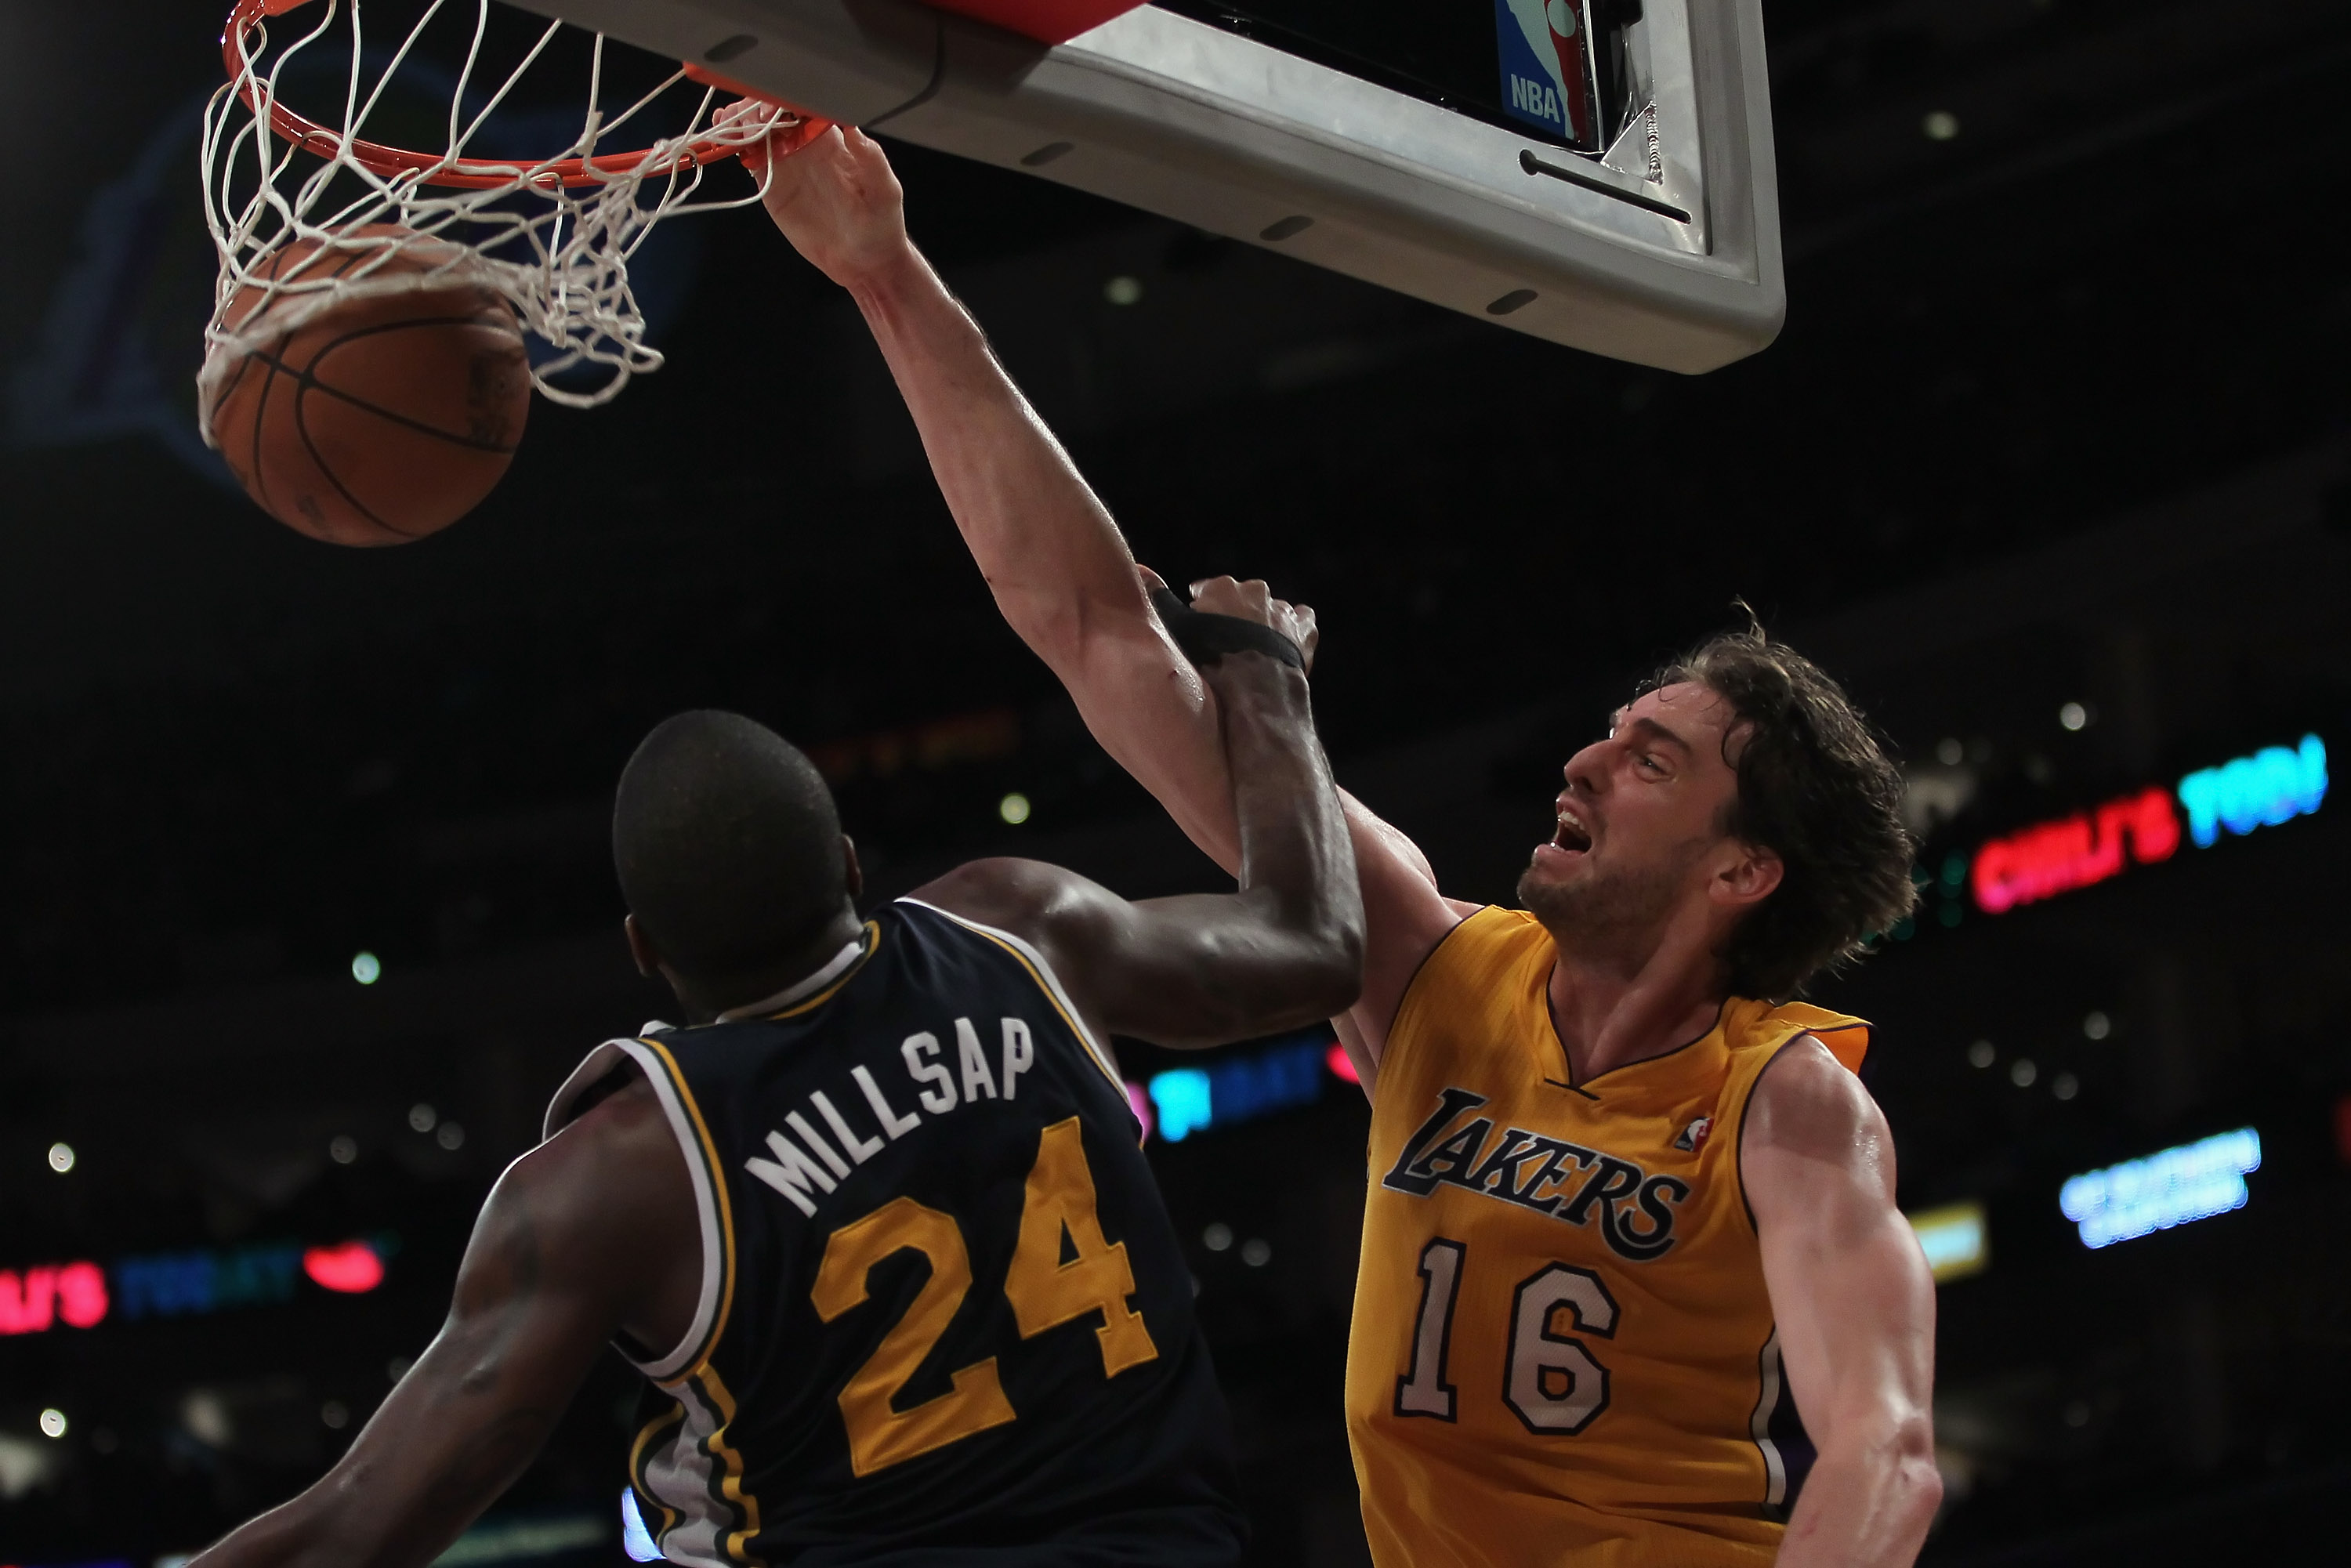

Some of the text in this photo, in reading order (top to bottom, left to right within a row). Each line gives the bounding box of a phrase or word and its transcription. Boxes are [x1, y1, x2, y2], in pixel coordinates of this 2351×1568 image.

[1510, 74, 1560, 123] NBA
[744, 1016, 1034, 1219] MILLSAP
[1381, 1086, 1691, 1262] LAKERS
[810, 1114, 1159, 1479] 24
[1393, 1235, 1621, 1436] 16
